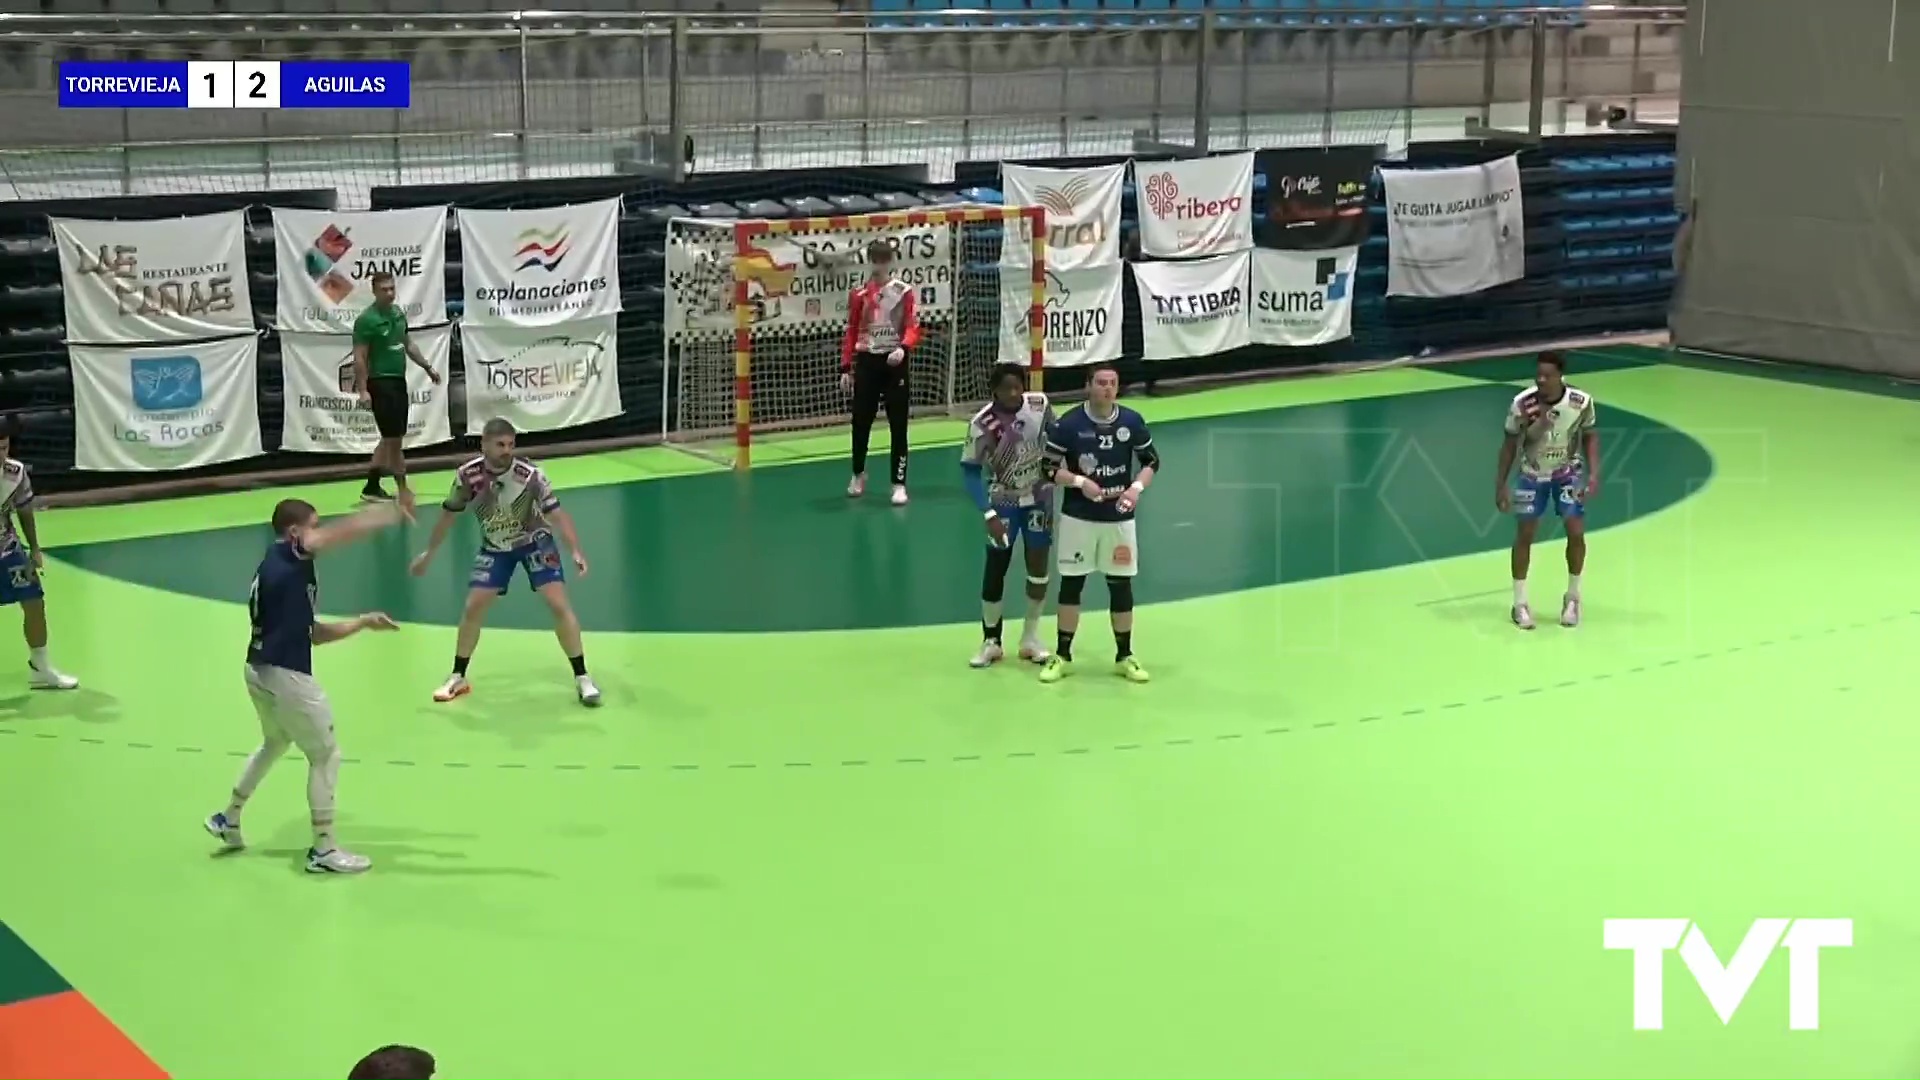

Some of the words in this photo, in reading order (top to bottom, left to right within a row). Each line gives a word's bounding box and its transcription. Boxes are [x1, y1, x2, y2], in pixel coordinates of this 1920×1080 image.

[1176, 196, 1242, 220] ribera
[1410, 202, 1443, 216] GUSTA
[361, 244, 422, 258] REFORMAS
[847, 233, 935, 264] KRTS
[142, 262, 229, 280] RESTAURANTE
[351, 257, 422, 280] JAIME
[475, 275, 608, 306] explanaciones
[790, 271, 872, 295] ORIHUEL
[1151, 294, 1182, 315] TVT
[1187, 286, 1241, 313] FIBRA
[1257, 290, 1324, 312] suma
[476, 355, 603, 391] TORREVIEJA
[113, 423, 150, 442] Las
[1099, 434, 1114, 449] 23
